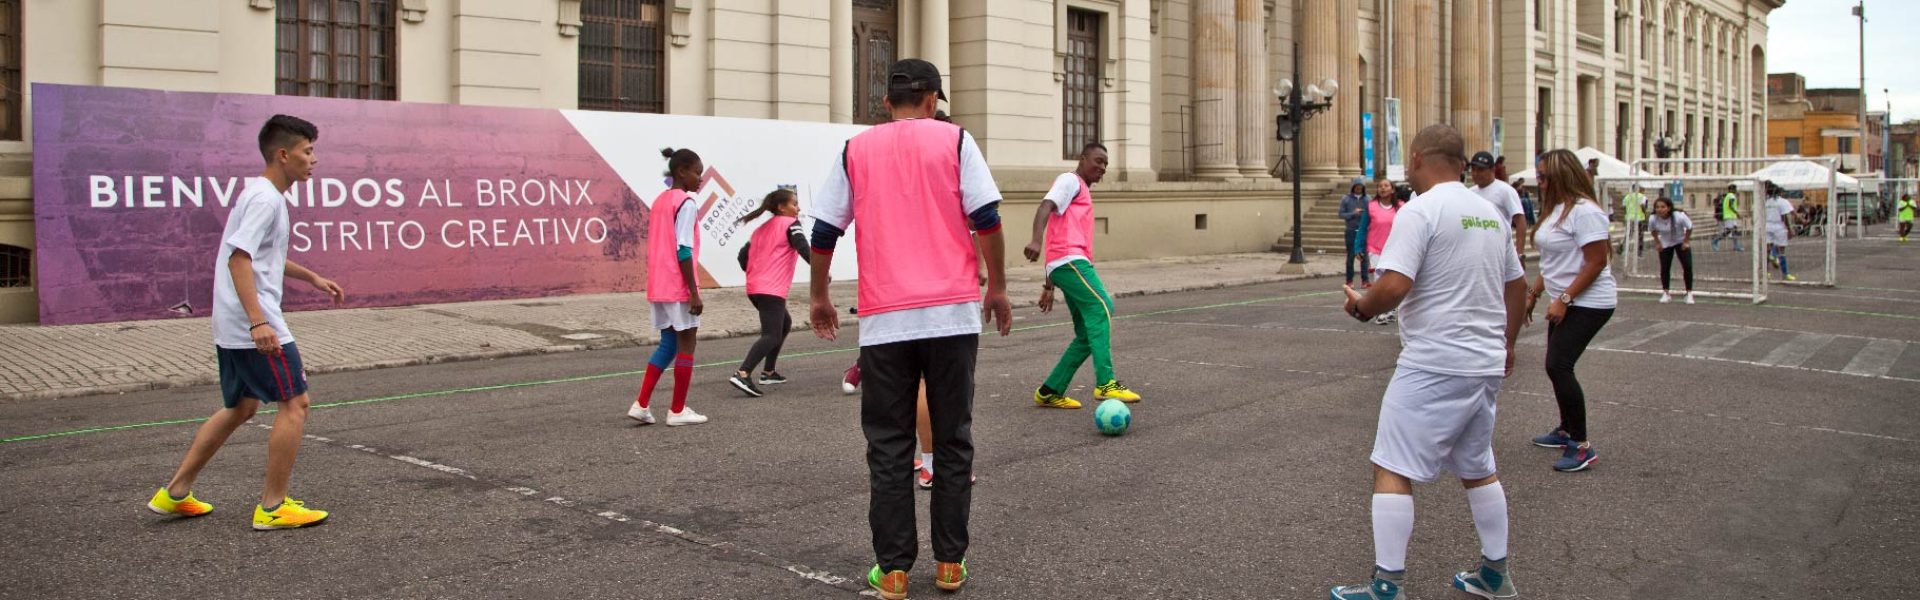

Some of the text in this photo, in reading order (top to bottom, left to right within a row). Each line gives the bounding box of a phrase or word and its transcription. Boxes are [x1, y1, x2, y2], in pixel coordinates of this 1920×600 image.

[418, 178, 462, 207] AL
[476, 179, 593, 207] BRONX
[703, 198, 729, 231] BRONX
[292, 217, 607, 252] STRITO CREATIVO
